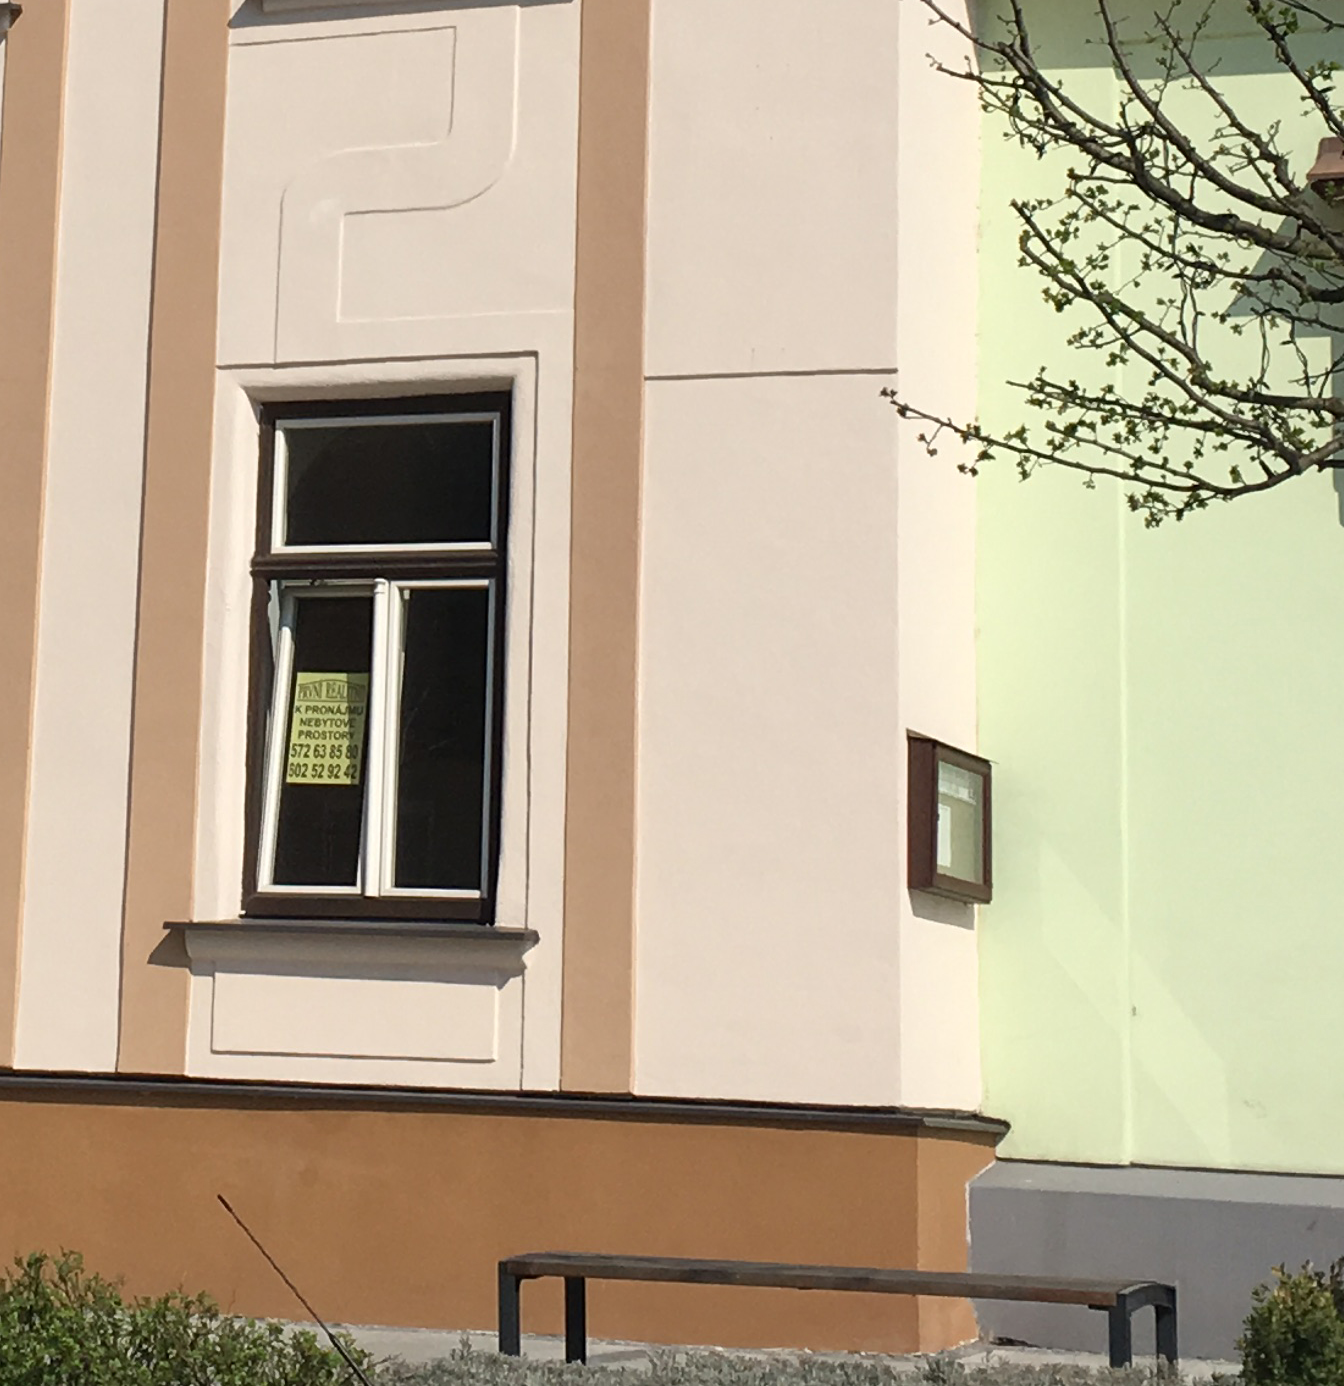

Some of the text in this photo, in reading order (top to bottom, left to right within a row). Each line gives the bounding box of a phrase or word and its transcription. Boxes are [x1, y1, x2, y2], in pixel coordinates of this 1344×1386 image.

[294, 704, 364, 715] K PRONÁJMU
[298, 730, 355, 740] PROSTORY
[290, 743, 310, 758] 572
[313, 744, 327, 758] 63
[329, 744, 342, 759] 85
[311, 764, 325, 779] 52
[327, 764, 341, 779] 92
[343, 764, 358, 779] 42
